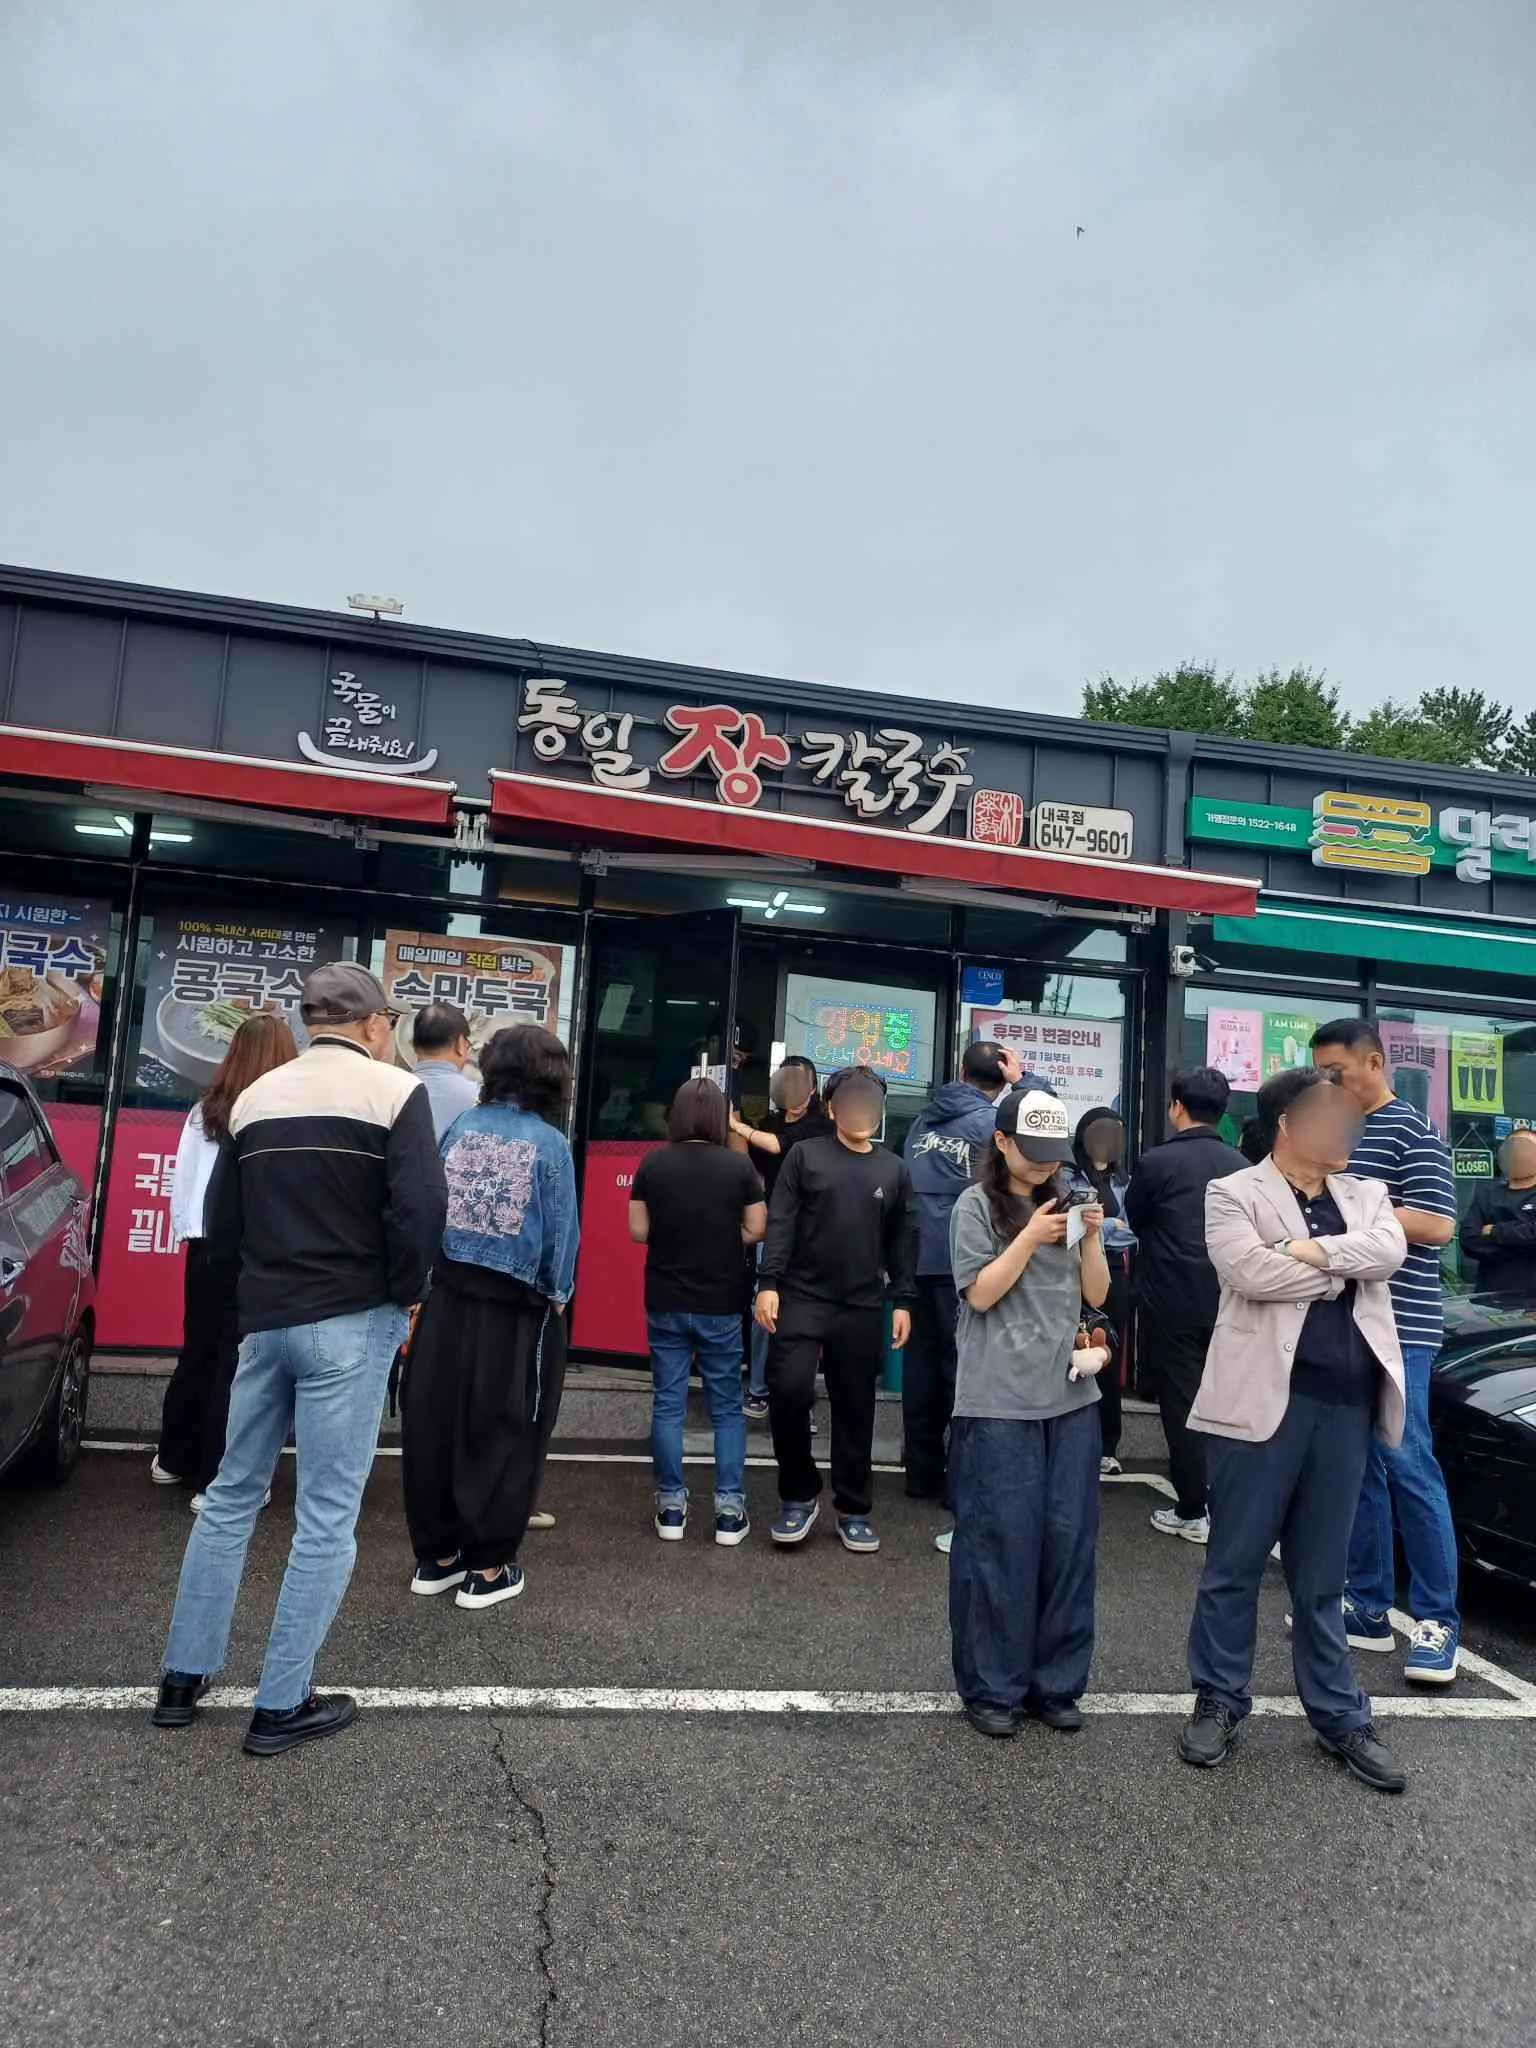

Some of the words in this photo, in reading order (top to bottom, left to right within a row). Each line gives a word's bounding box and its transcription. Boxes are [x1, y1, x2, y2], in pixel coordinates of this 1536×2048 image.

[331, 671, 397, 725] 국물이
[325, 717, 416, 758] 끝내줘요!
[1041, 807, 1085, 826] 내곡점
[1248, 817, 1297, 832] 1522-1648
[1041, 824, 1129, 856] 647-9601
[178, 920, 211, 934] 100%
[214, 923, 248, 936] 국내산
[294, 930, 317, 943] 만든
[0, 930, 96, 979] 국수
[176, 934, 253, 957] 시원하고
[258, 942, 317, 963] 고소한
[398, 945, 463, 967] 매일매일
[465, 951, 498, 970] 직접
[500, 954, 533, 974] 빚는
[171, 958, 306, 1011] 콩국수
[815, 1005, 912, 1050] 영업중
[993, 1022, 1038, 1042] 휴무일
[1042, 1027, 1102, 1048] 변경안내
[1022, 1050, 1037, 1061] 7월
[1040, 1051, 1071, 1063] 1일부터
[1048, 1064, 1075, 1076] 수요일
[1047, 1075, 1070, 1088] 니다.
[134, 1152, 178, 1198] 국물
[1456, 1160, 1490, 1173] CLOSED
[127, 1208, 181, 1255] 끝내
